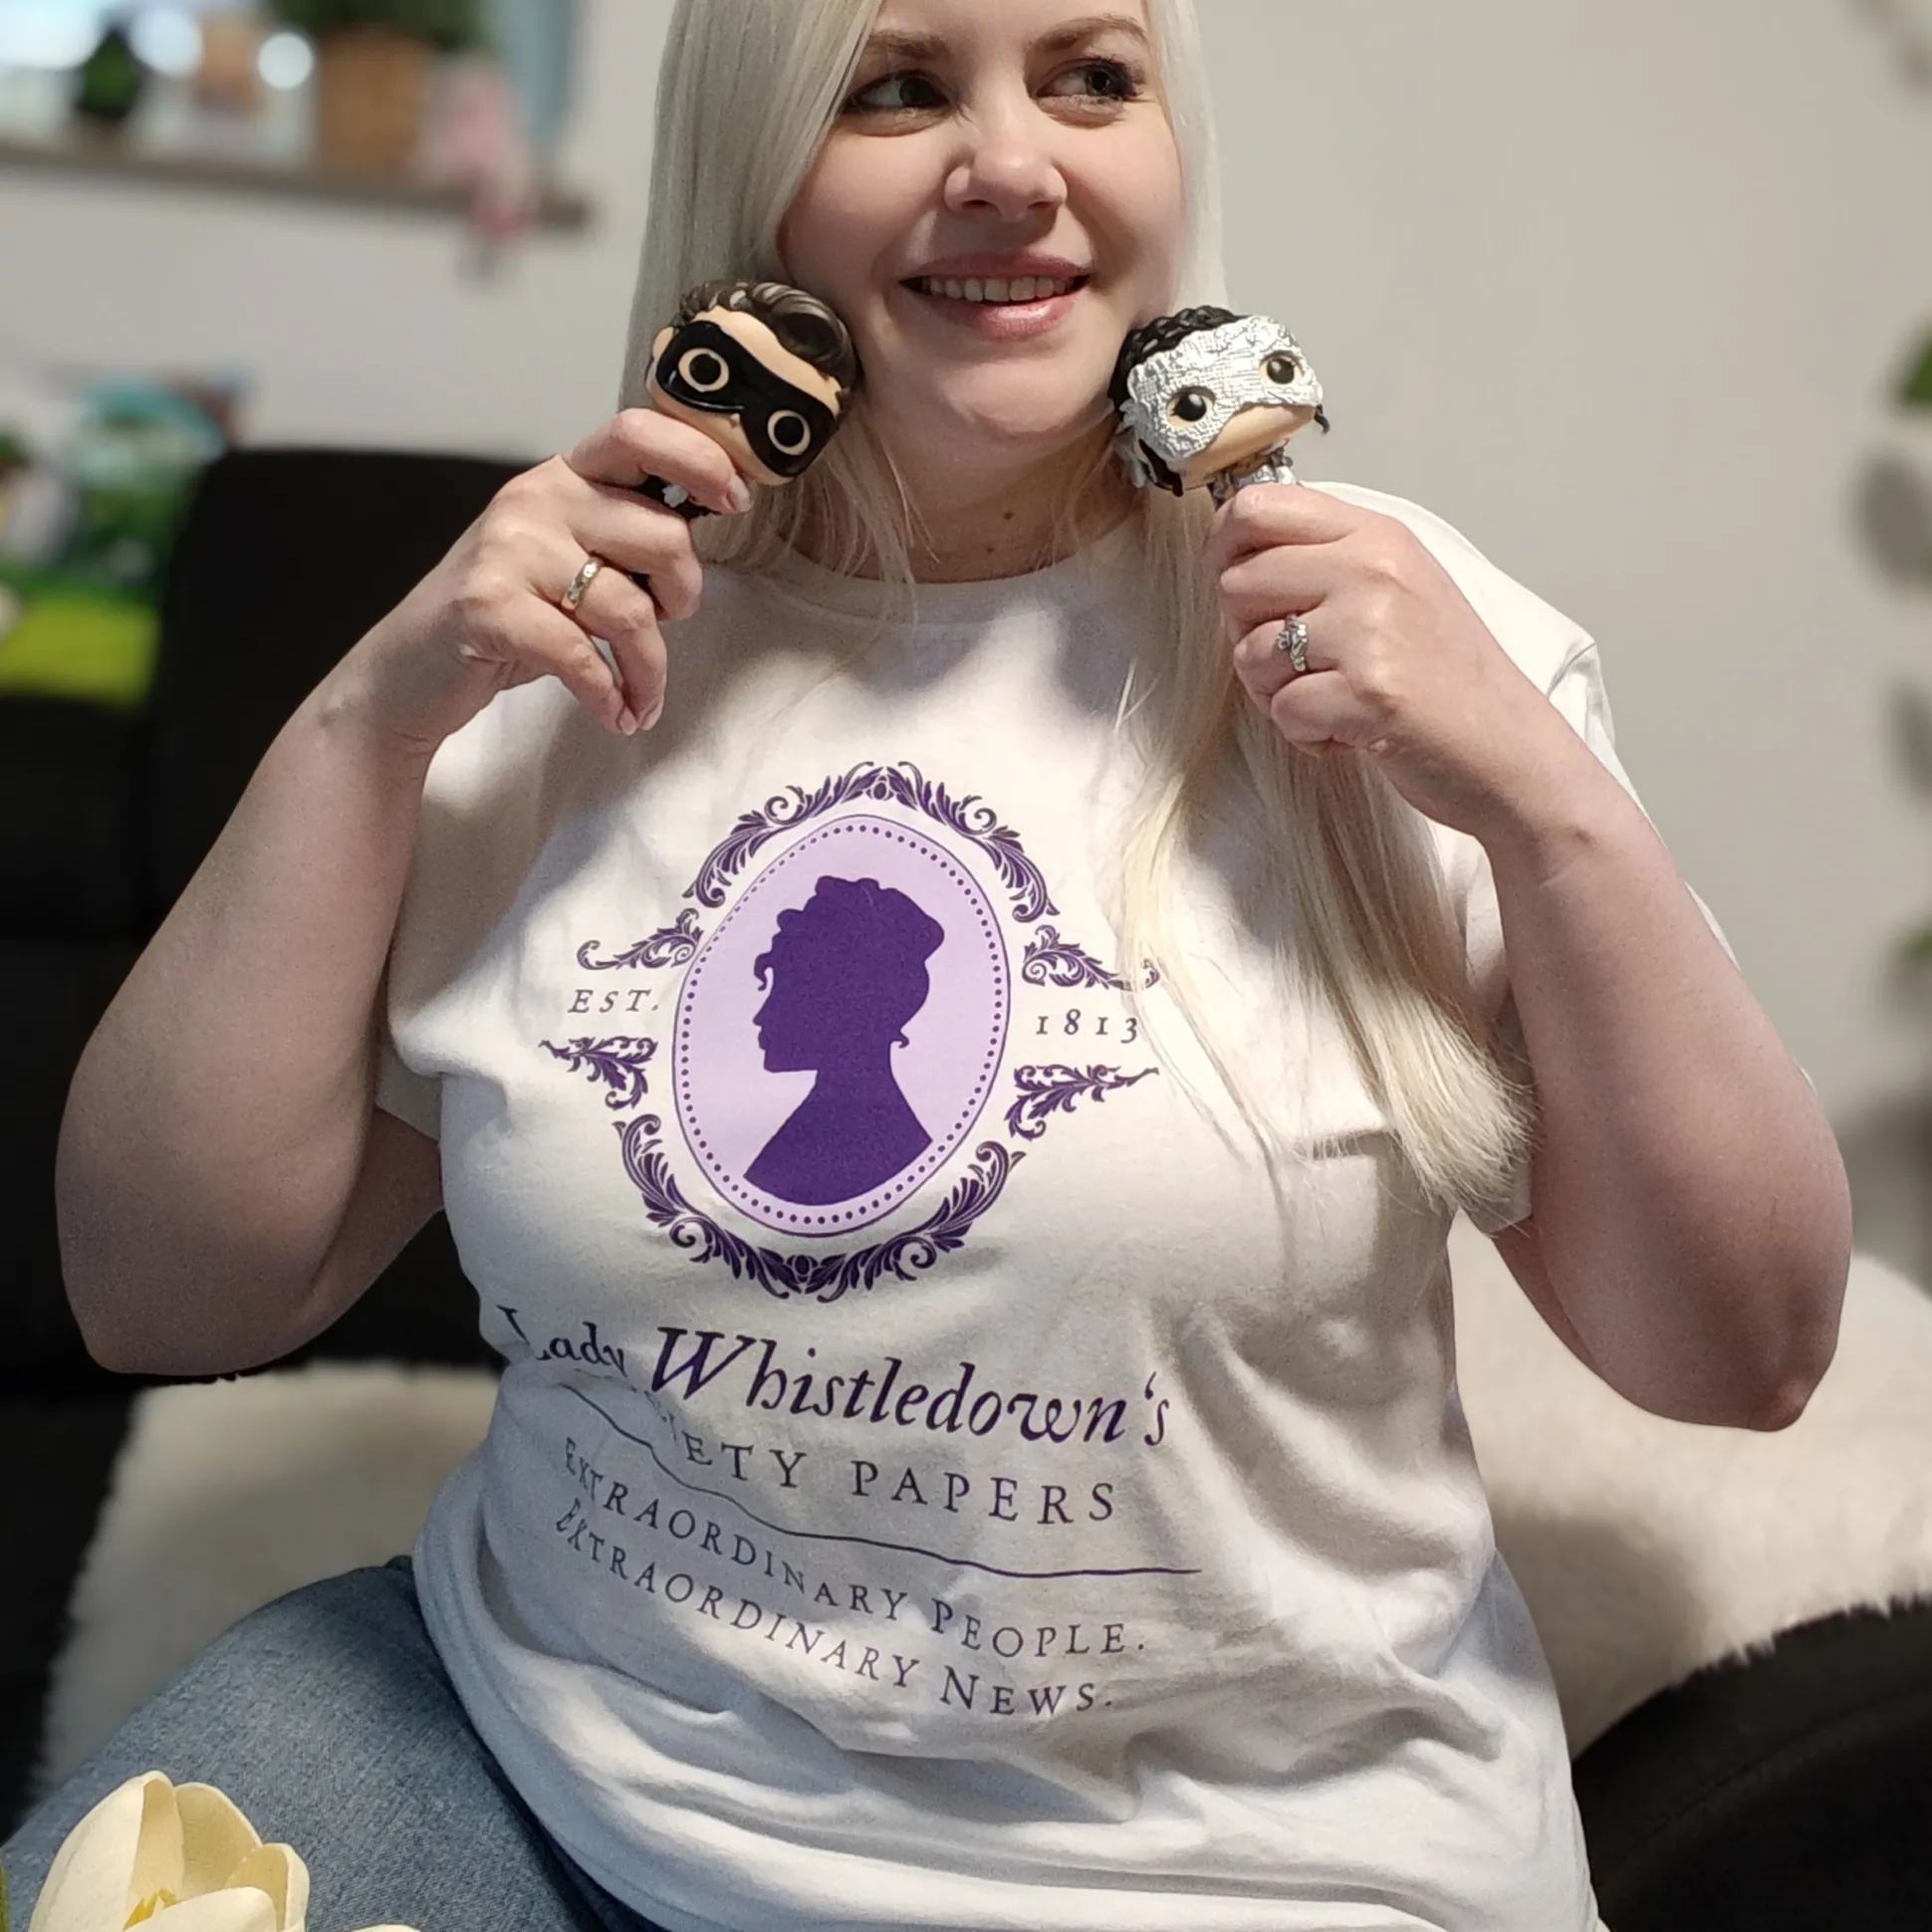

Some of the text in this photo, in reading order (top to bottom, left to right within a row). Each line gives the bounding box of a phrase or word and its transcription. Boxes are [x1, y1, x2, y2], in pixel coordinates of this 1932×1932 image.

[567, 989, 659, 1014] EST.
[1036, 1008, 1137, 1045] 1813
[841, 1460, 1114, 1525] PAPERS
[565, 1436, 1145, 1658] EXTRAORDINARY PEOPLE.
[556, 1498, 1113, 1716] EXTRAORDINARY NEWS.
